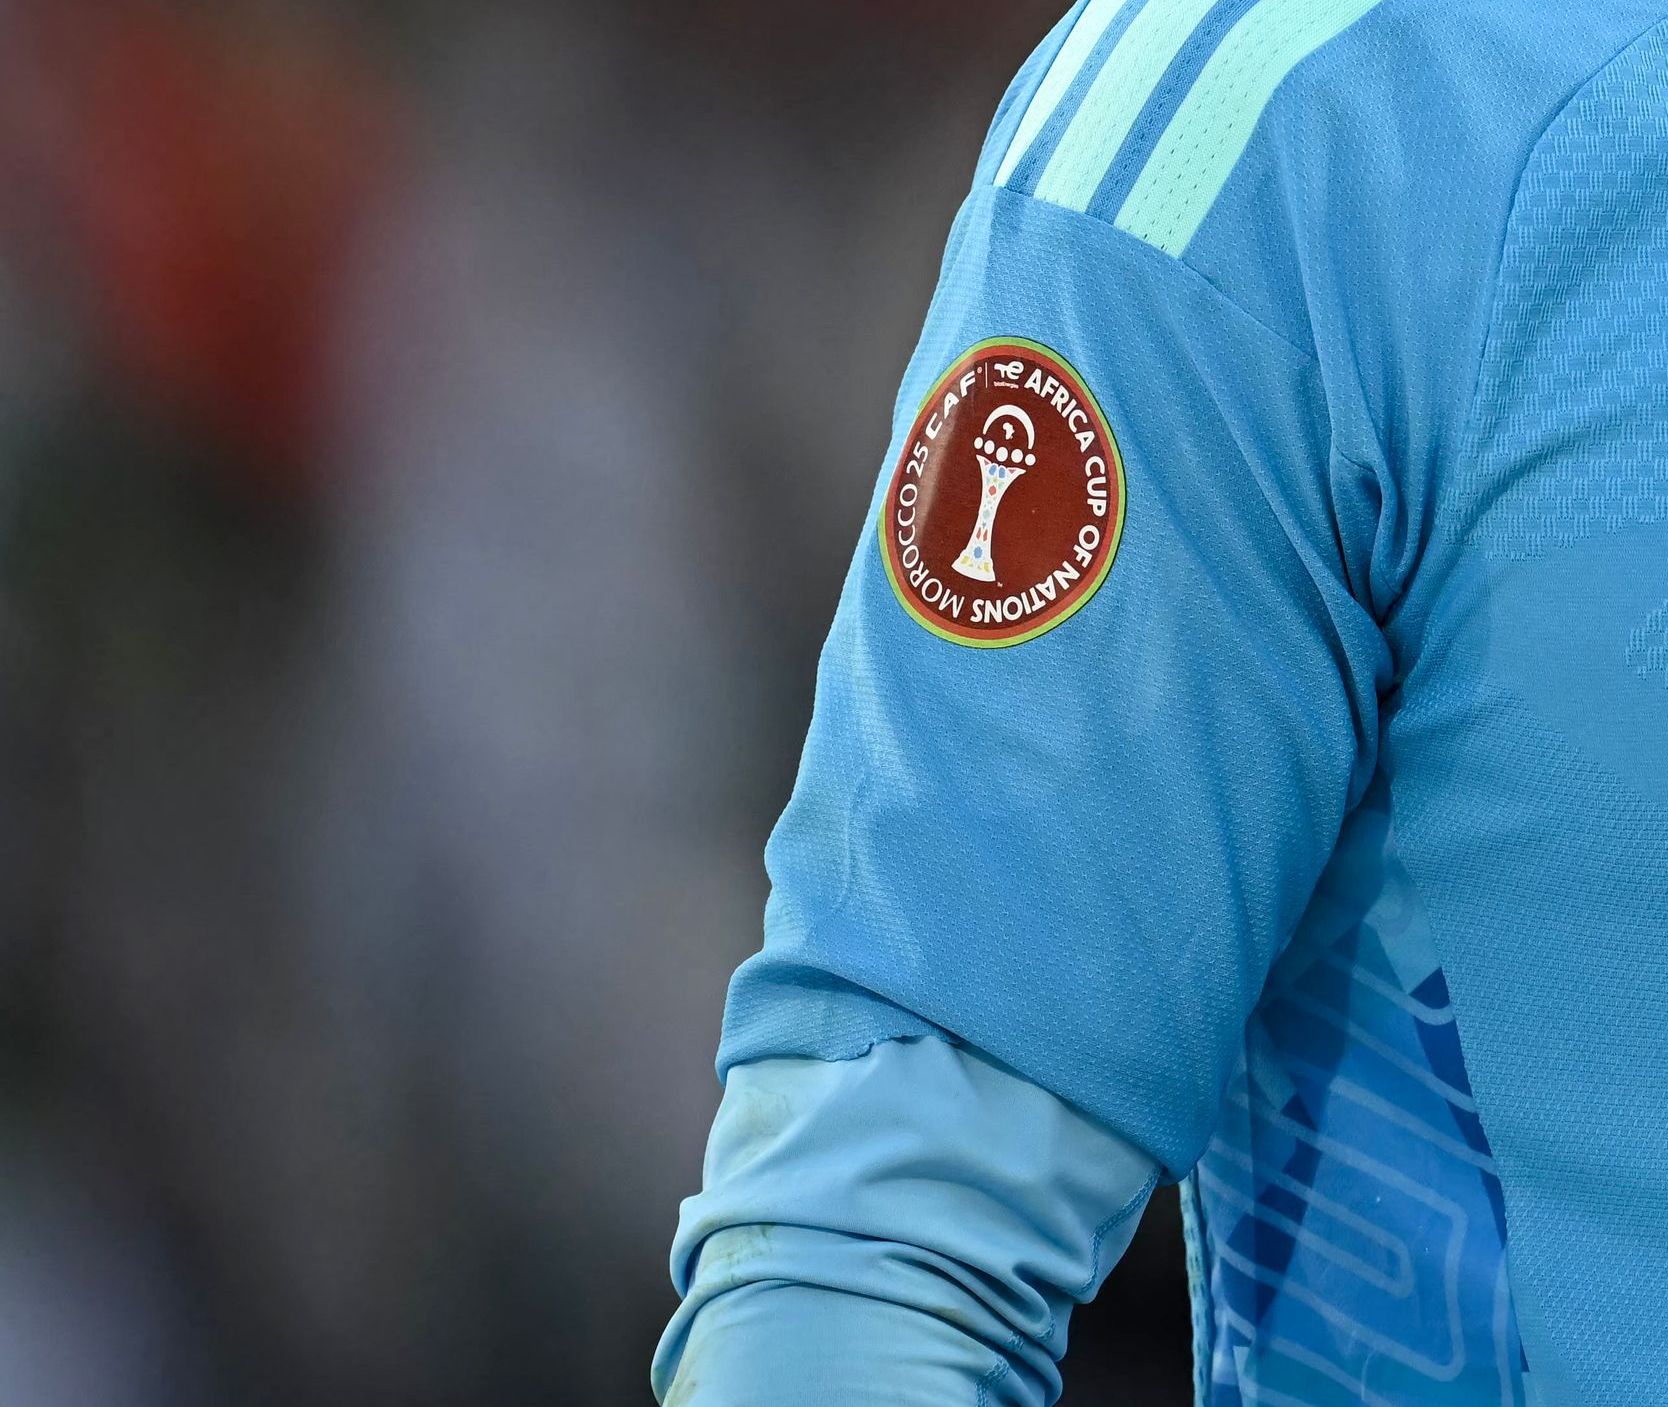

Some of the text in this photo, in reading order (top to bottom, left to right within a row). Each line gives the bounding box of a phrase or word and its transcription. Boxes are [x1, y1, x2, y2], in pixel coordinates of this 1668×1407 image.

[926, 371, 976, 440] CAF
[897, 442, 965, 618] MOROCCO 25
[971, 368, 1108, 623] AFRICA CUP OF NATIONS
